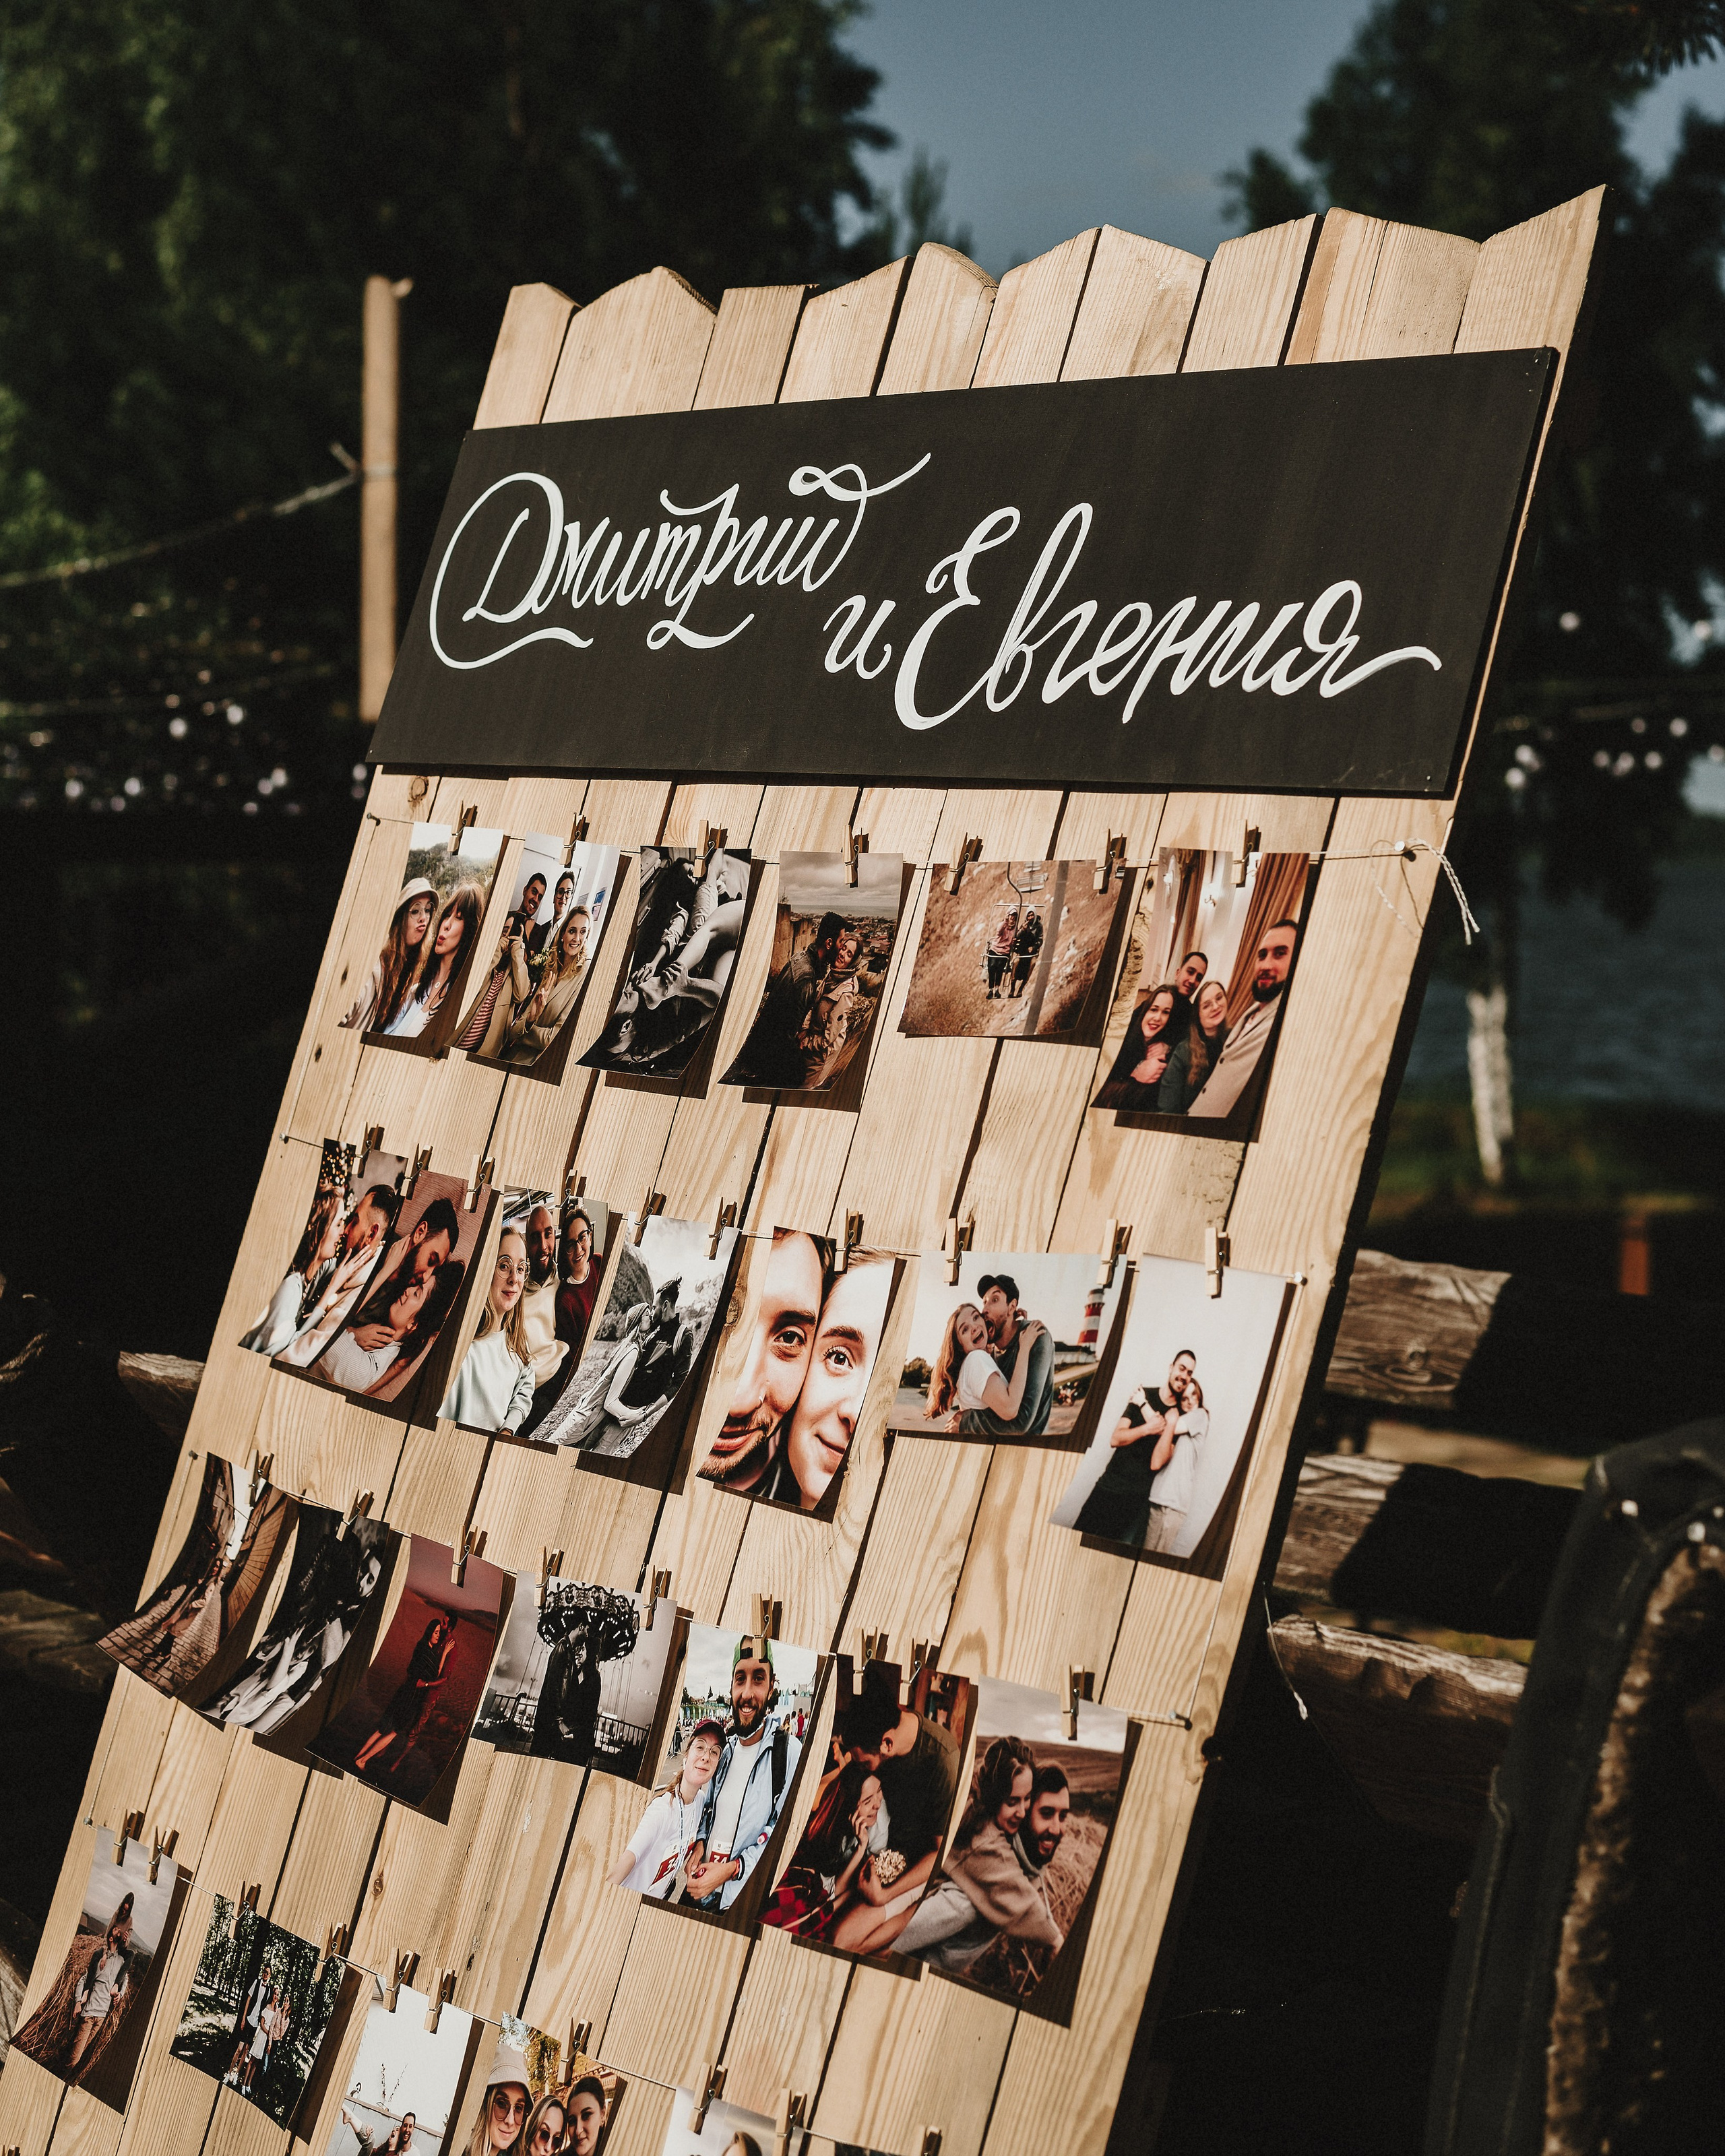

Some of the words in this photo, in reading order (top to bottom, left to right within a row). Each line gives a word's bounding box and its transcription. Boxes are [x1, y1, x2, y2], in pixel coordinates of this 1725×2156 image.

[430, 453, 931, 669] Дмитрий
[823, 595, 896, 679] и
[895, 503, 1442, 730] Евгения
